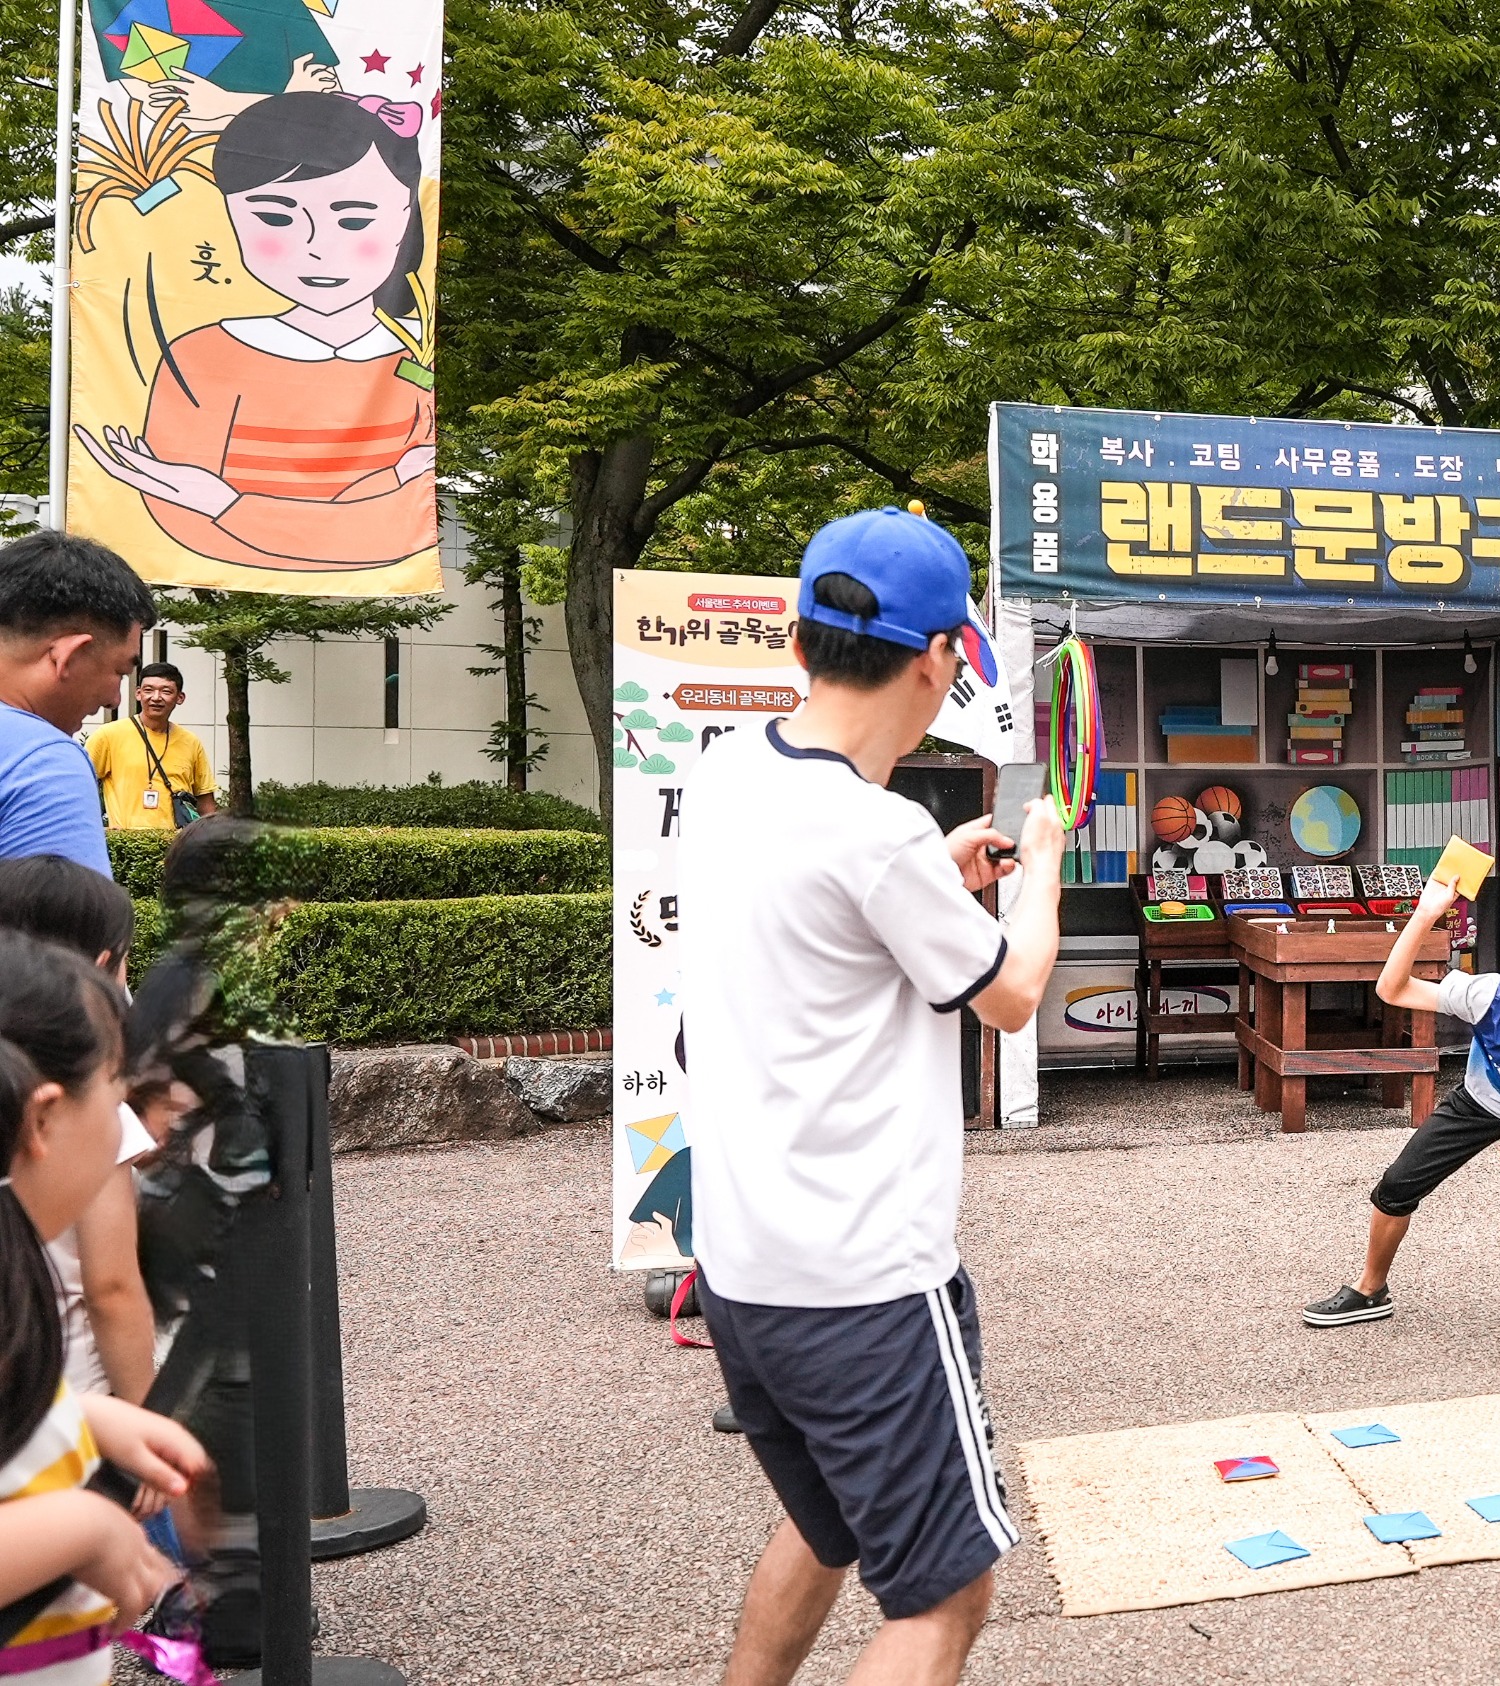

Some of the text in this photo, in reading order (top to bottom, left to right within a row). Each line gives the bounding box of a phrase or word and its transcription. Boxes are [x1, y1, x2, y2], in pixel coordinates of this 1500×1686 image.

[1100, 437, 1155, 466] 복사
[1189, 443, 1231, 471] 코팅
[1274, 447, 1380, 478] 사무용품
[1414, 455, 1463, 482] 도장
[1030, 433, 1060, 573] 학용품
[695, 598, 779, 611] 서울랜드 추석 이벤트
[636, 615, 710, 646] 한가위
[680, 689, 795, 707] 우리동네 골목대장
[622, 1069, 667, 1096] 하하
